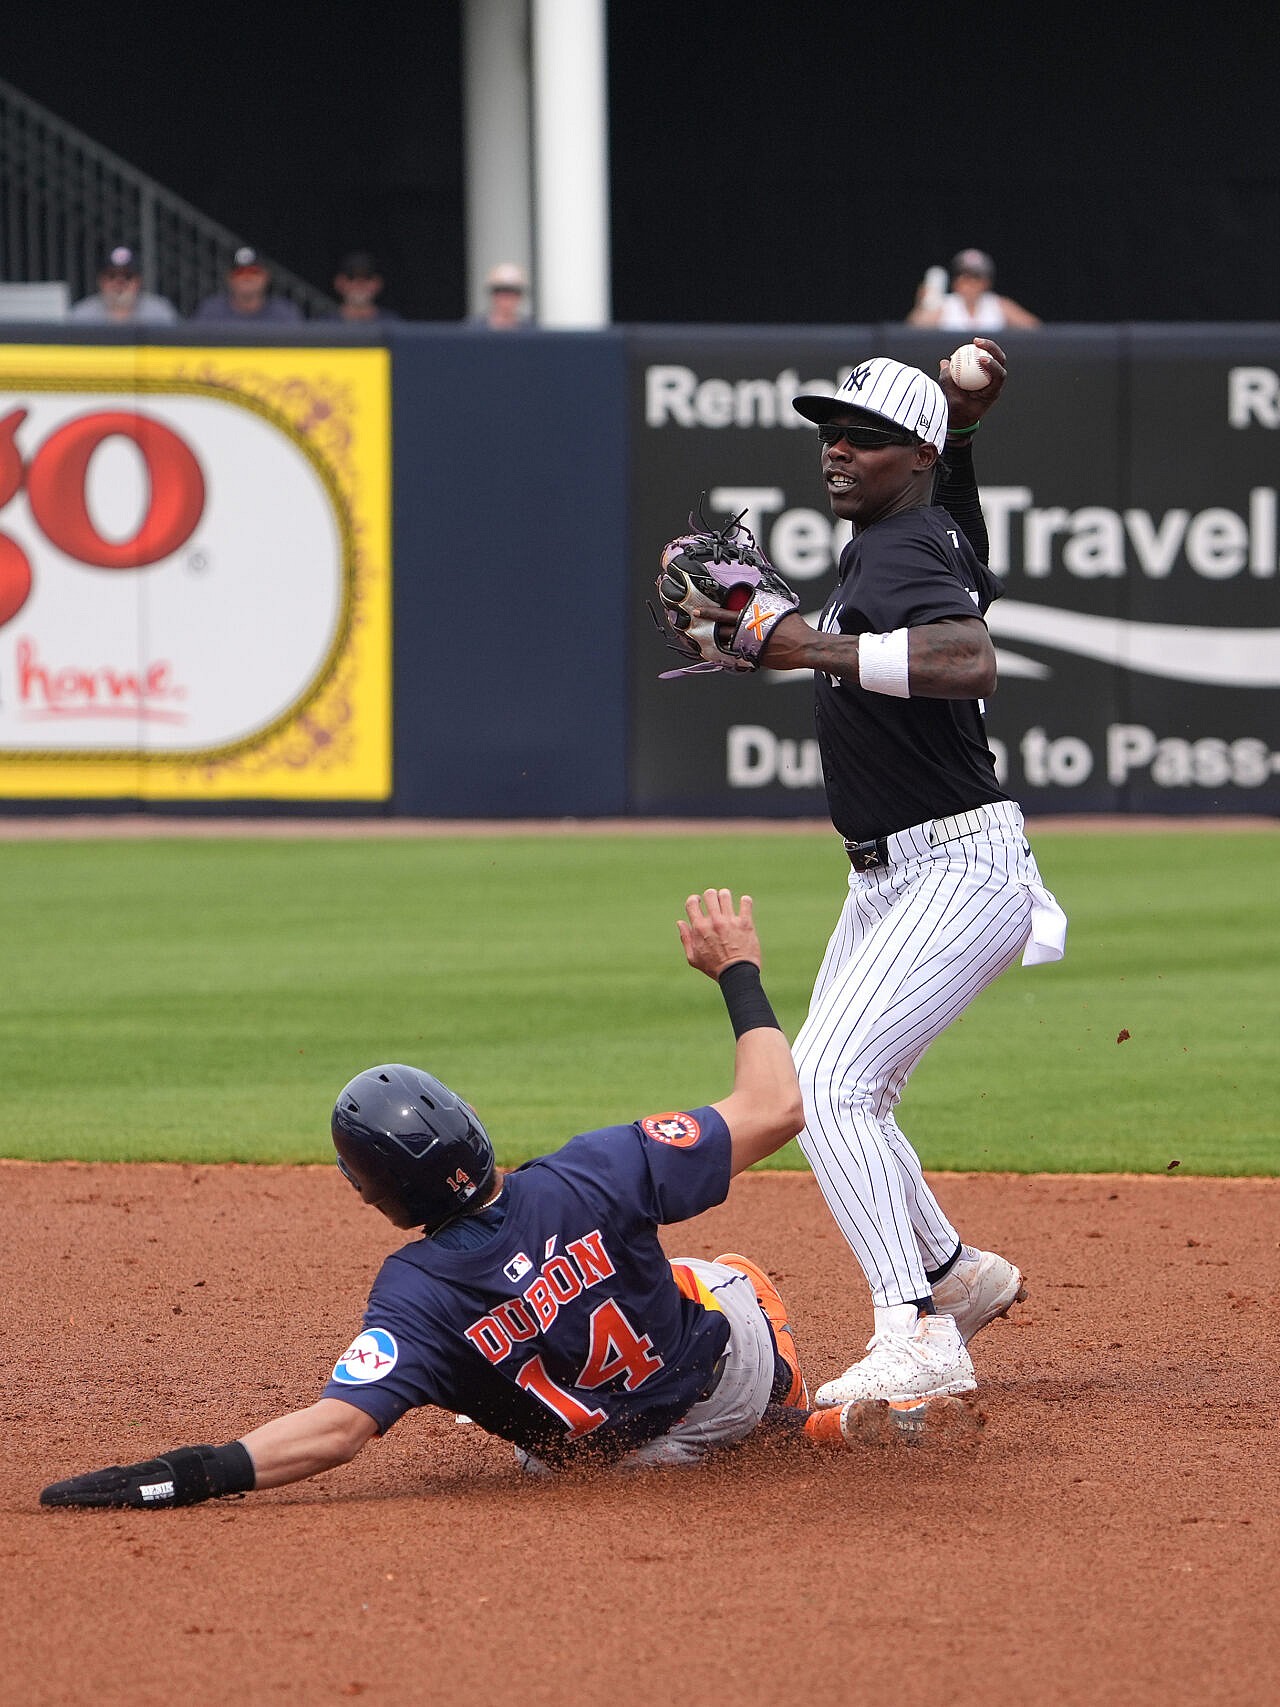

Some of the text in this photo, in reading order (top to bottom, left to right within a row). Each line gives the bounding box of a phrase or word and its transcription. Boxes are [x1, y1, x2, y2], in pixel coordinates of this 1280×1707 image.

[0, 405, 206, 628] o
[1020, 726, 1094, 788] to
[446, 1168, 470, 1192] 14
[464, 1229, 617, 1366] DUBÓN
[515, 1297, 665, 1442] 14
